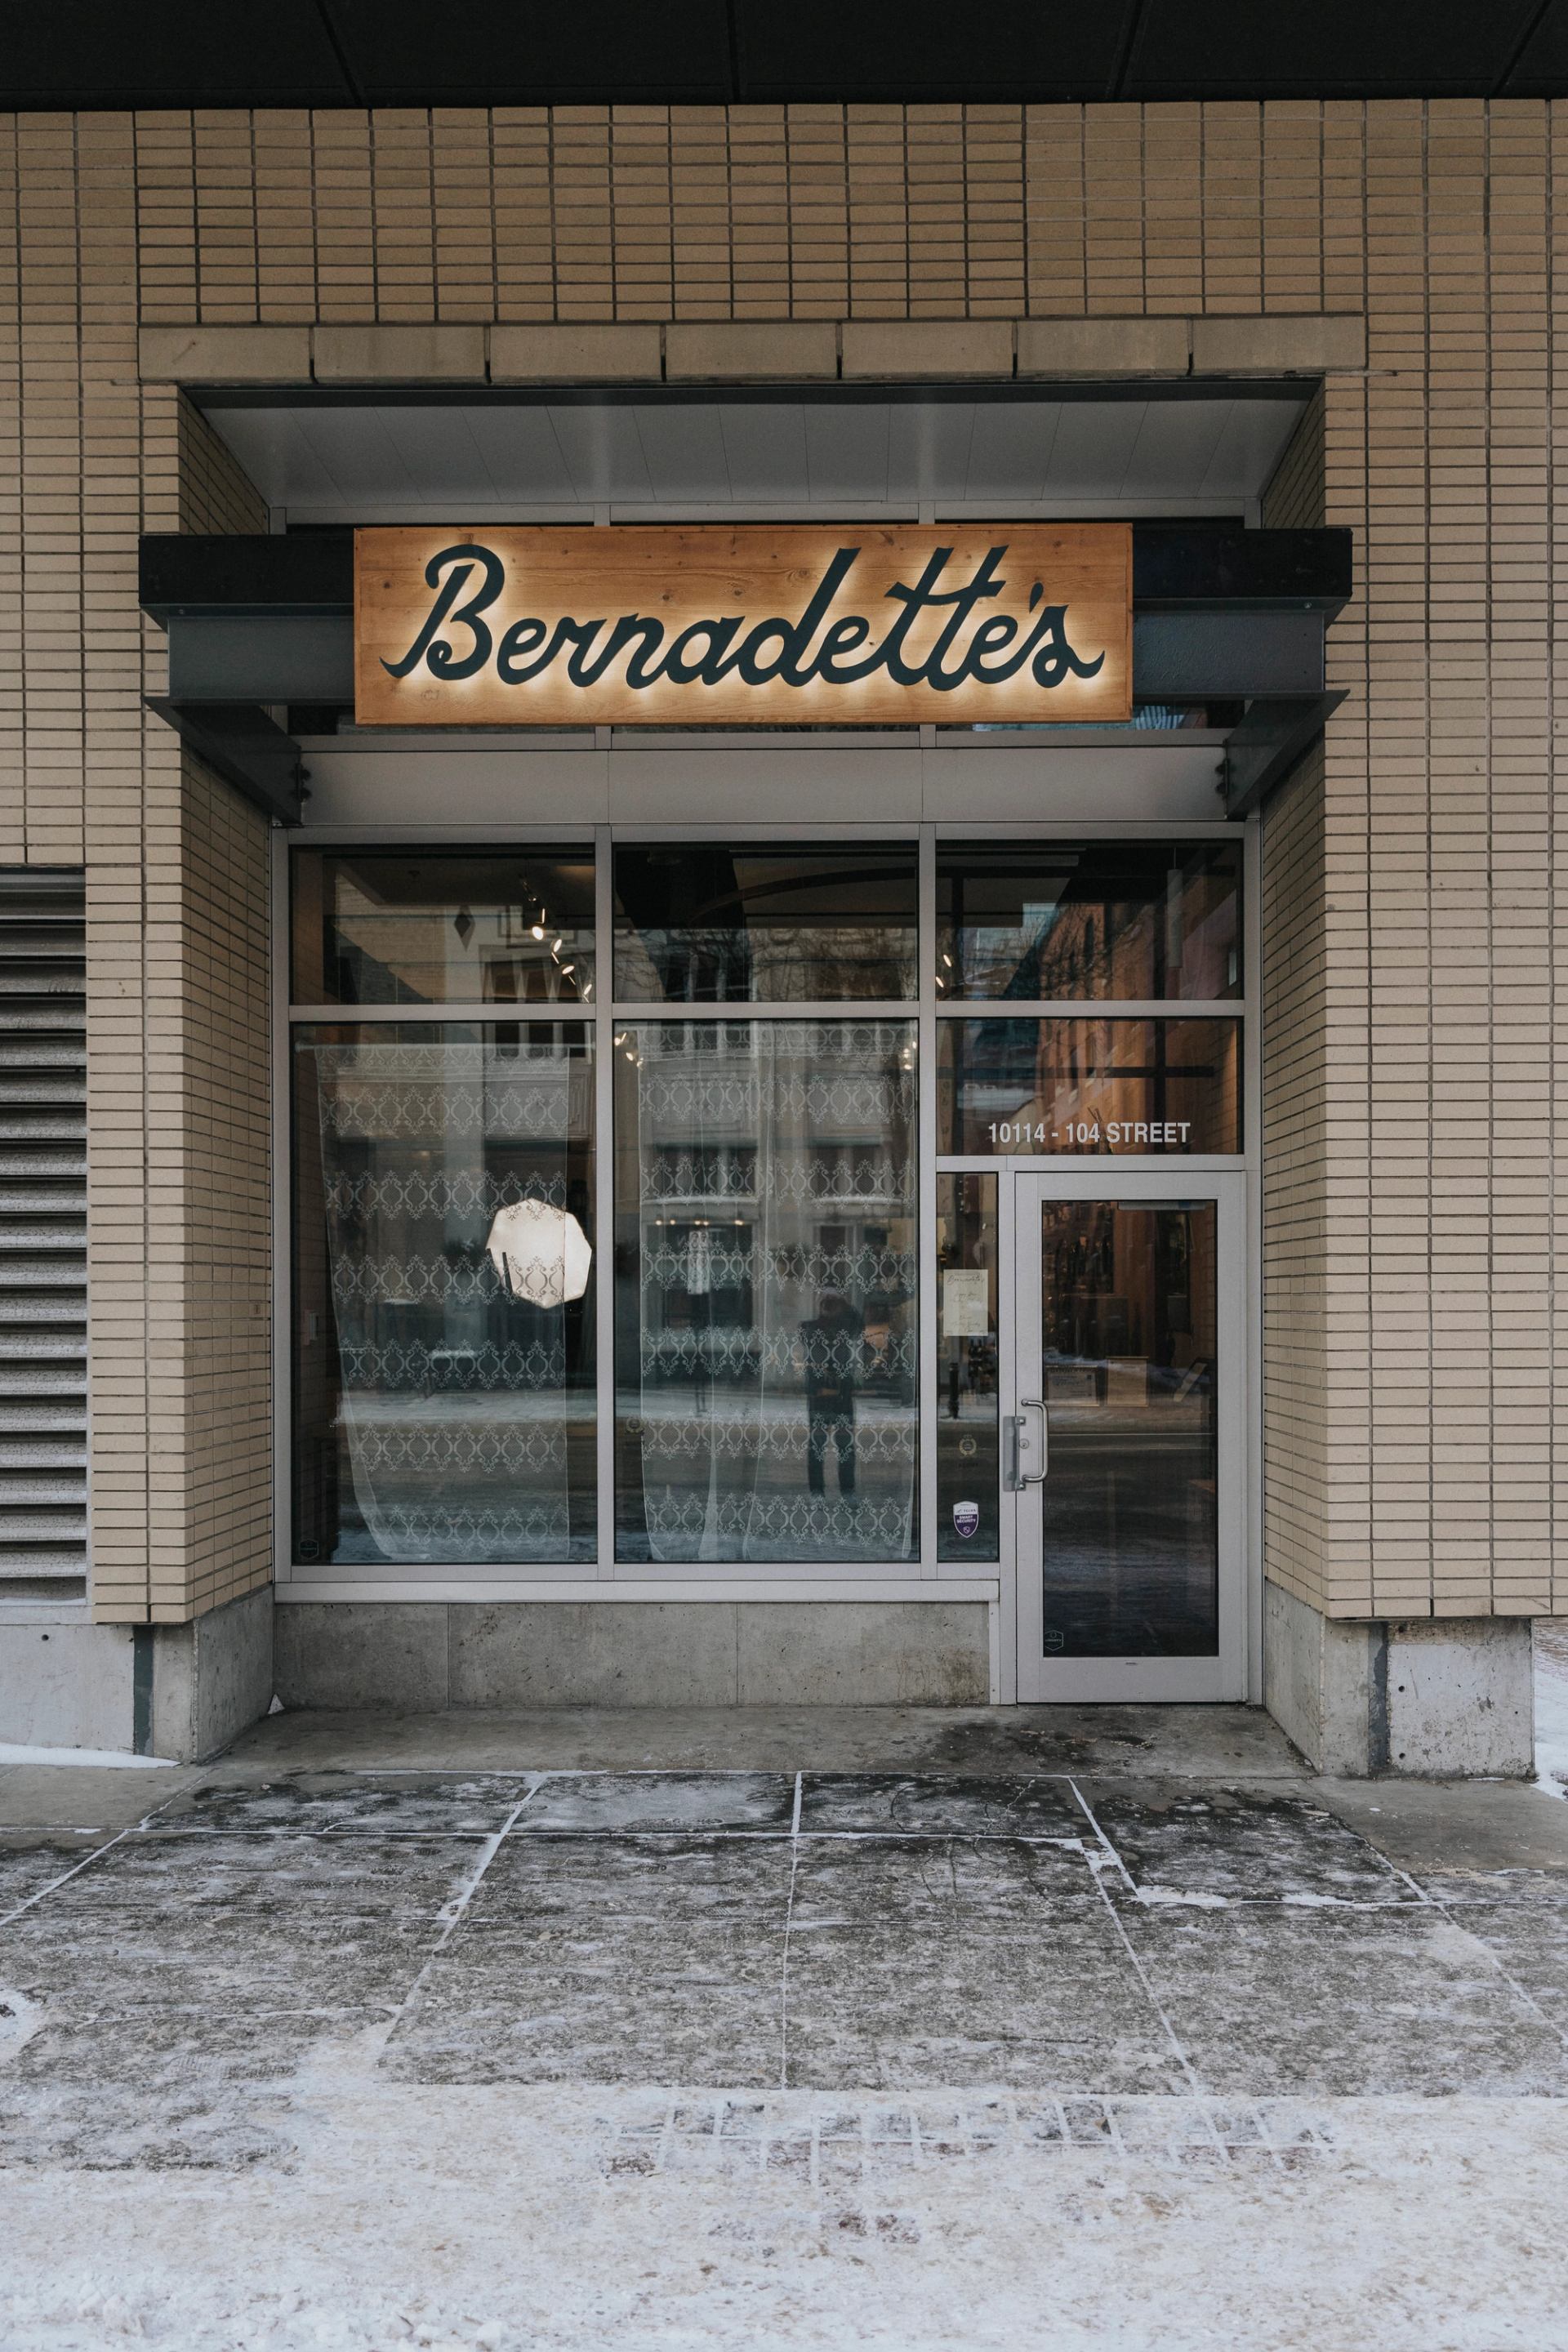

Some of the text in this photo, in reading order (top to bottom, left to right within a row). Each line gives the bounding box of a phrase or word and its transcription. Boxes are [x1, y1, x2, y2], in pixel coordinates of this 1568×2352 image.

[379, 543, 1106, 690] Bernadette's
[989, 1122, 1045, 1143] 10114
[1066, 1122, 1100, 1143] 104
[1107, 1122, 1191, 1143] STREET
